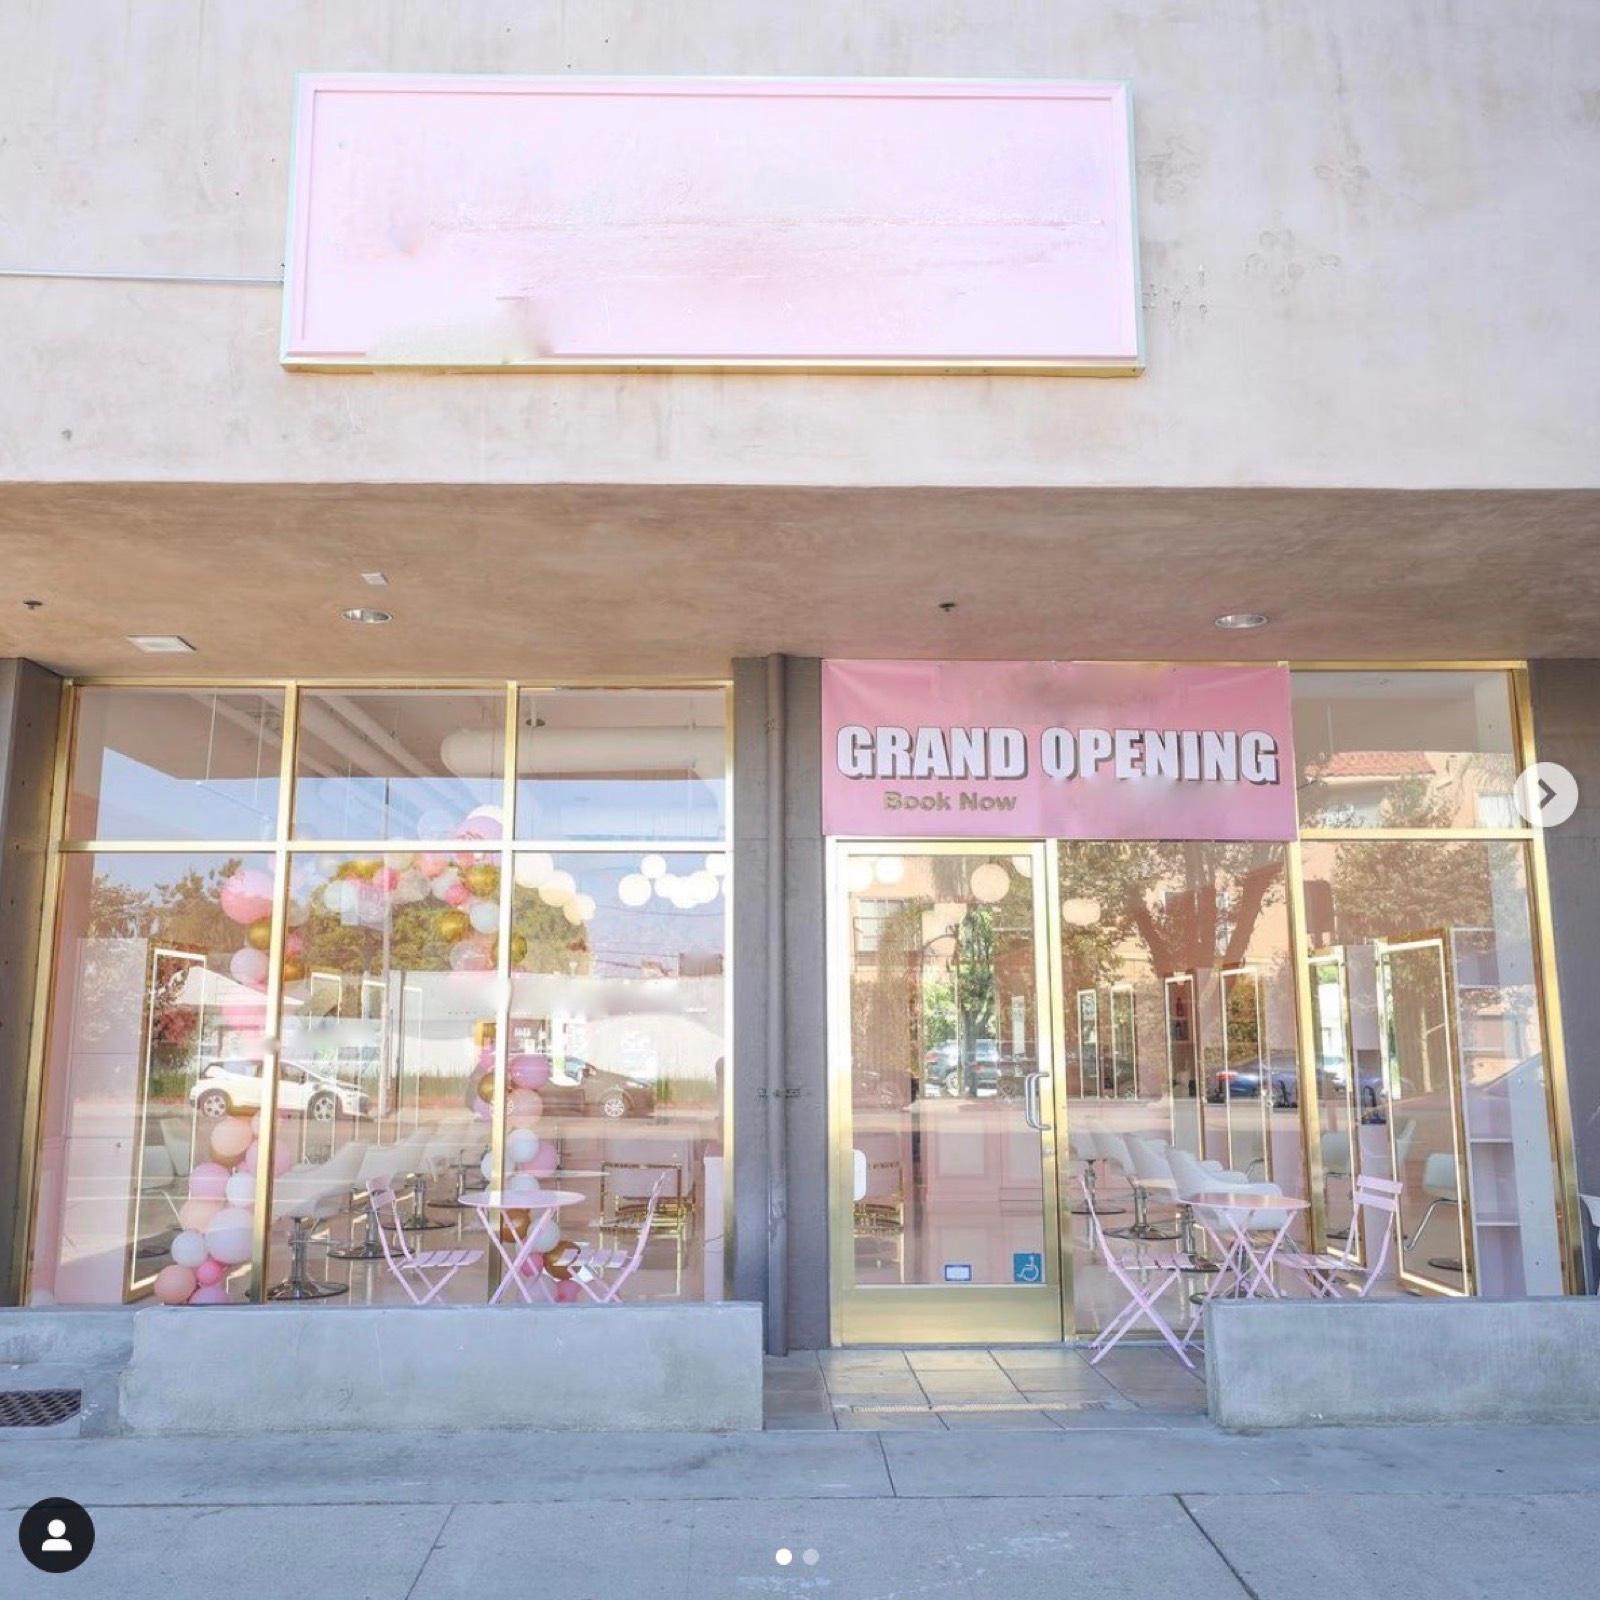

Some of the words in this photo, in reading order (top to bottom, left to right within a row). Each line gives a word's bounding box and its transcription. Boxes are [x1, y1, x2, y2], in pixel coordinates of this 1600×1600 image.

[836, 726, 1028, 780] GRAND
[1041, 727, 1279, 785] OPENING
[884, 791, 951, 811] Book
[959, 791, 1018, 811] Now
